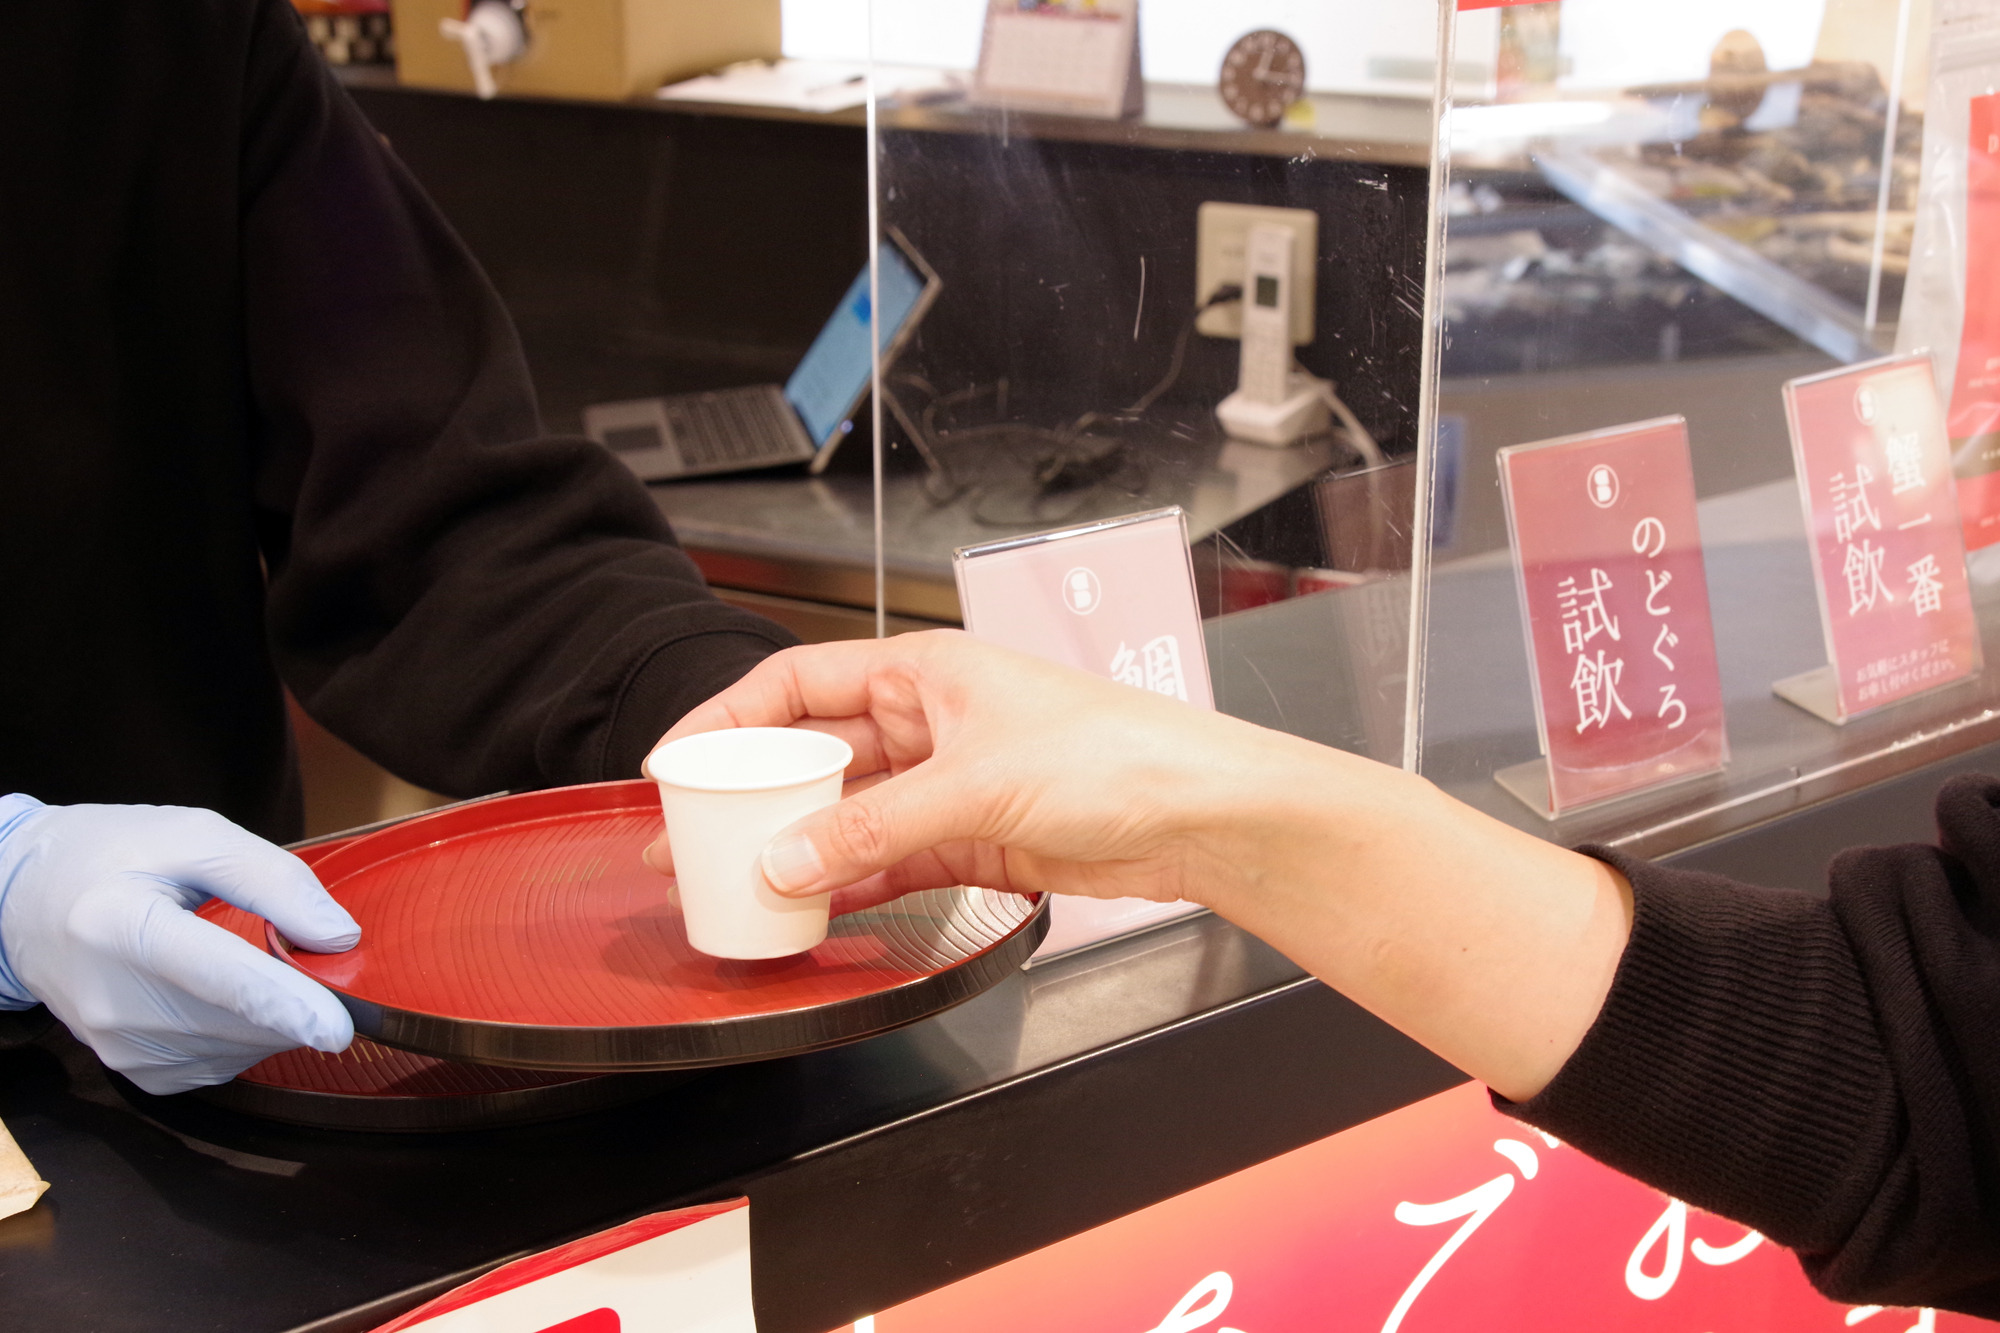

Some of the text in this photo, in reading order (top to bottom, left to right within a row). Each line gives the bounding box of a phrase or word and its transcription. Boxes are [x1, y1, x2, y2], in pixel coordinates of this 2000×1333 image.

[1829, 463, 1895, 617] 試飲
[1885, 431, 1943, 618] 蟹一番
[1556, 567, 1633, 735] 試飲
[1631, 516, 1687, 730] のどぐろ
